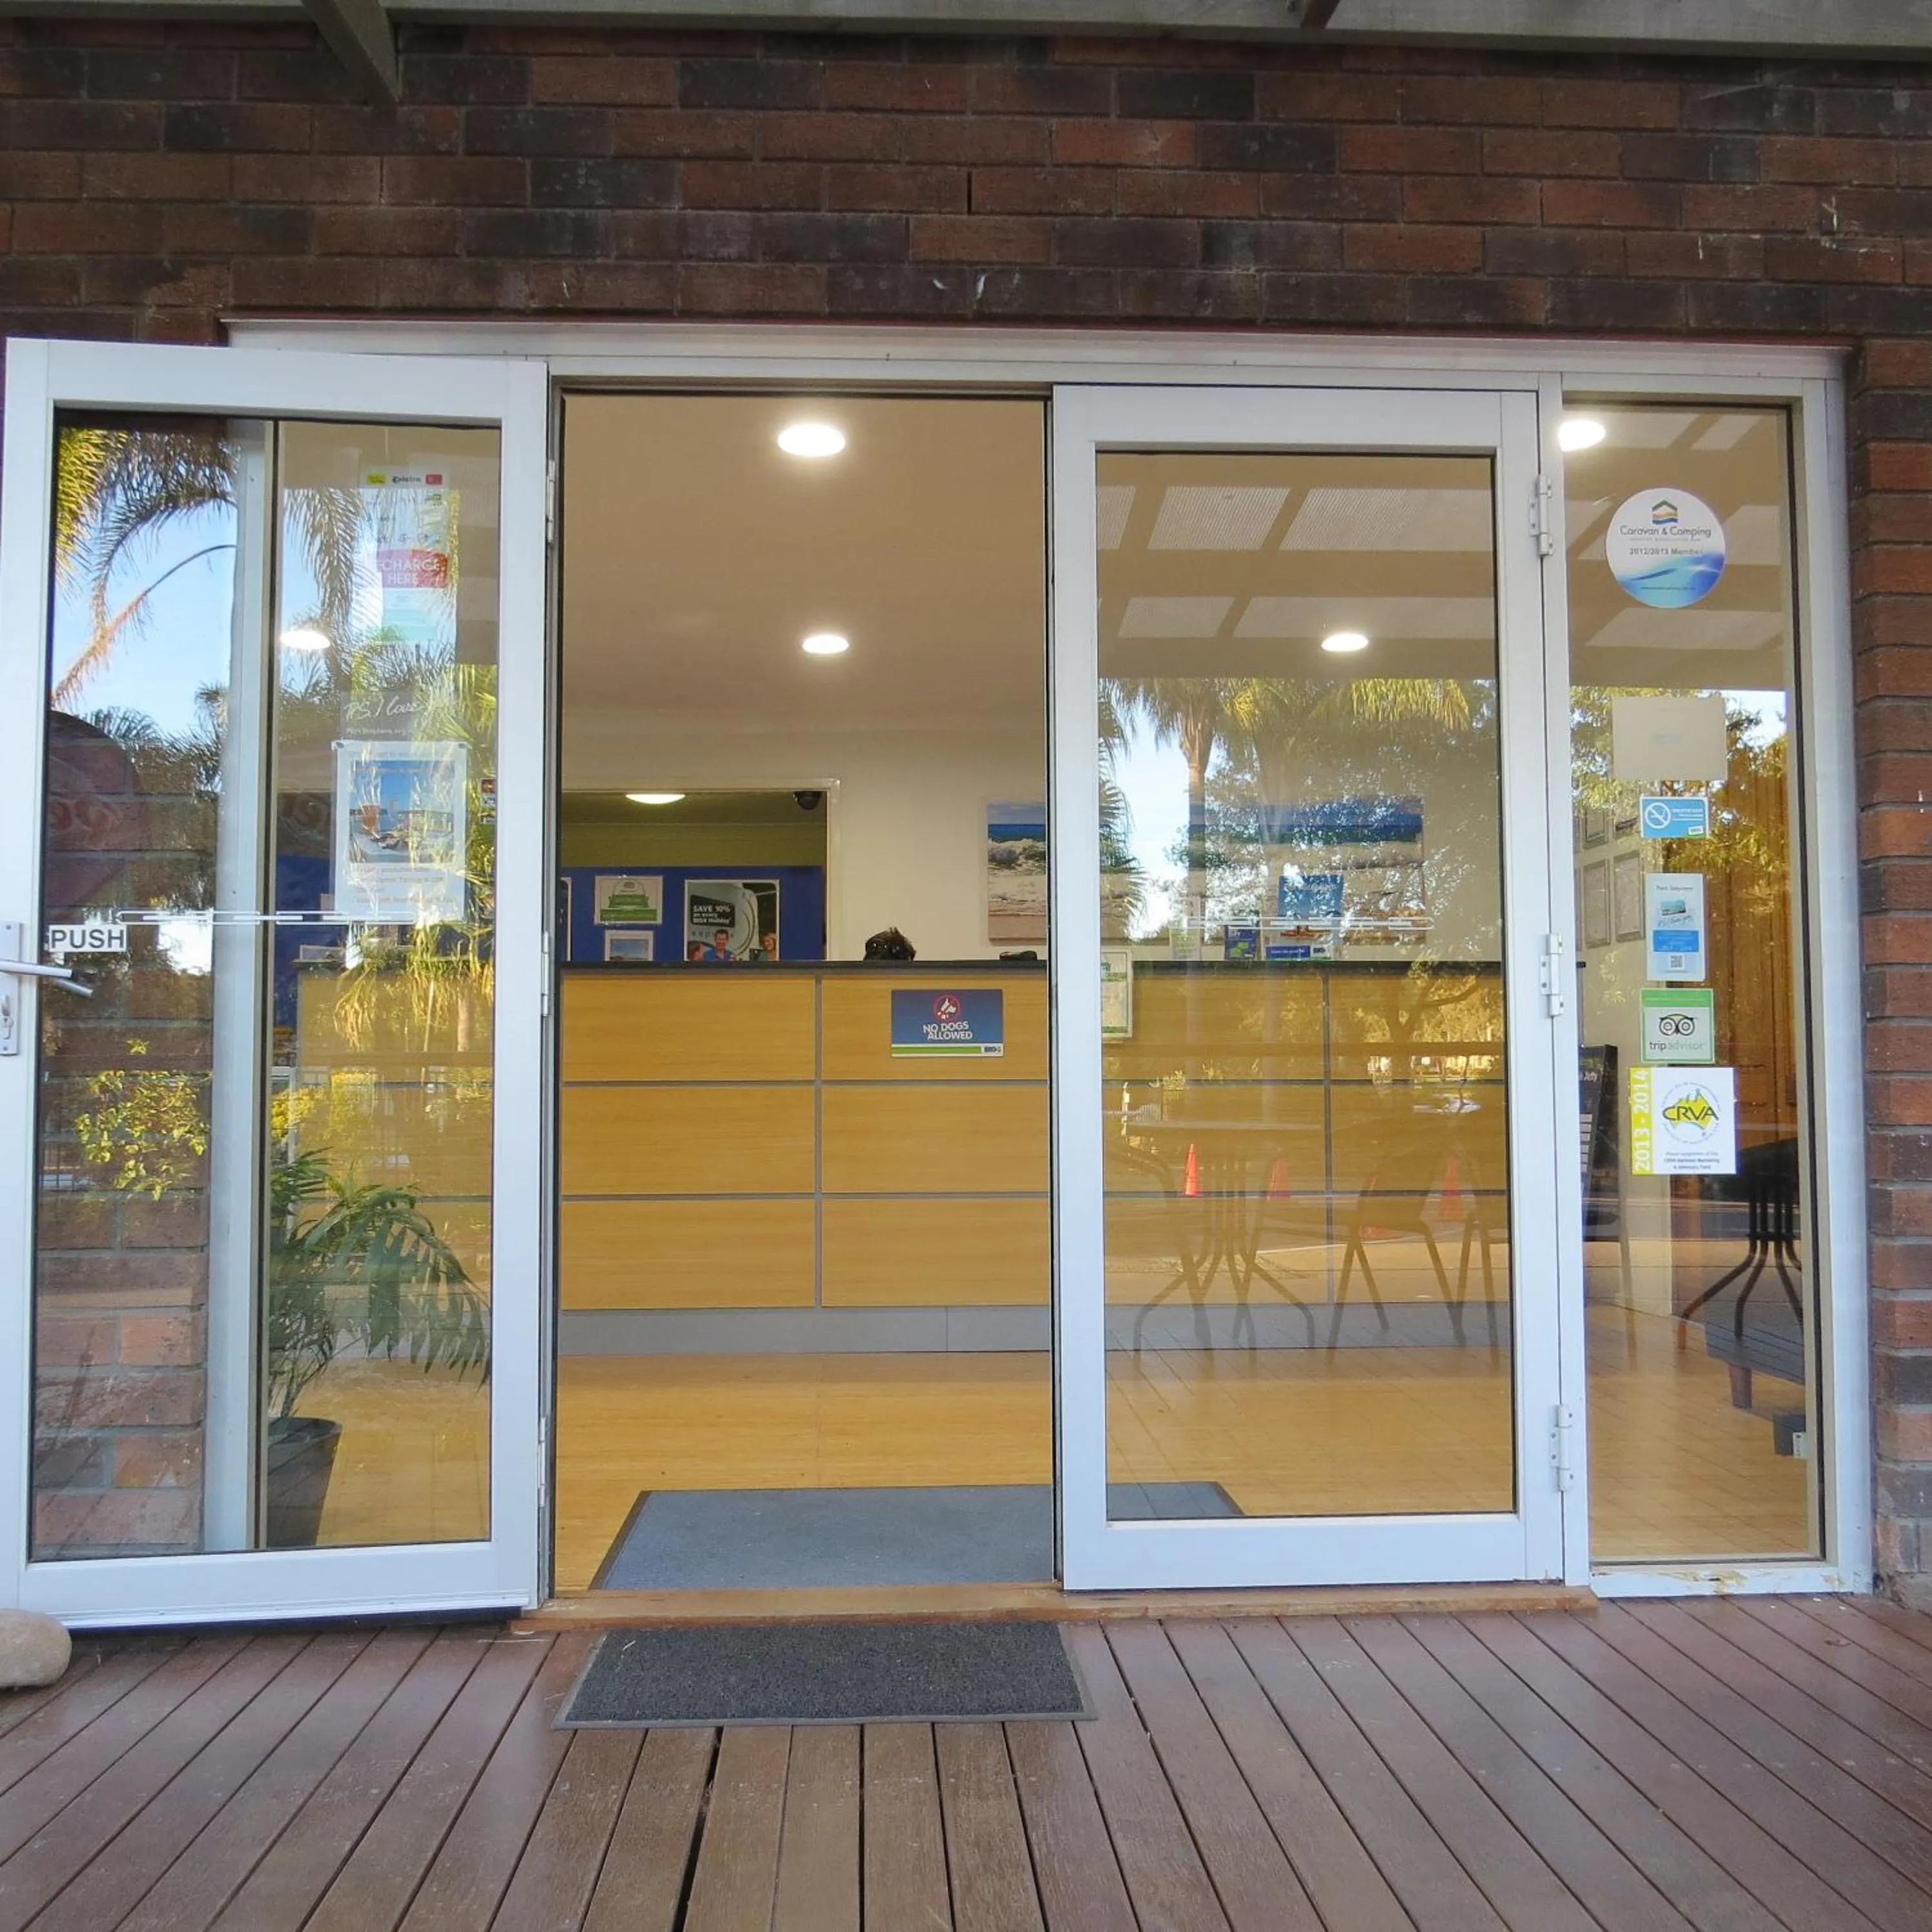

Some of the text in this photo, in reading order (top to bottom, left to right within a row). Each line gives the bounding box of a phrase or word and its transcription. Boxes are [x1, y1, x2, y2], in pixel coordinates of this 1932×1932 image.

[1619, 525, 1711, 538] Caravan & Camping
[51, 929, 125, 949] PUSH
[923, 1020, 969, 1033] NO DOGS
[927, 1031, 973, 1040] ALLOWED
[1649, 1040, 1704, 1052] tripadvisor
[1633, 1069, 1650, 1113] 2014
[1661, 1105, 1720, 1122] CRVA
[1633, 1128, 1650, 1172] 2013
